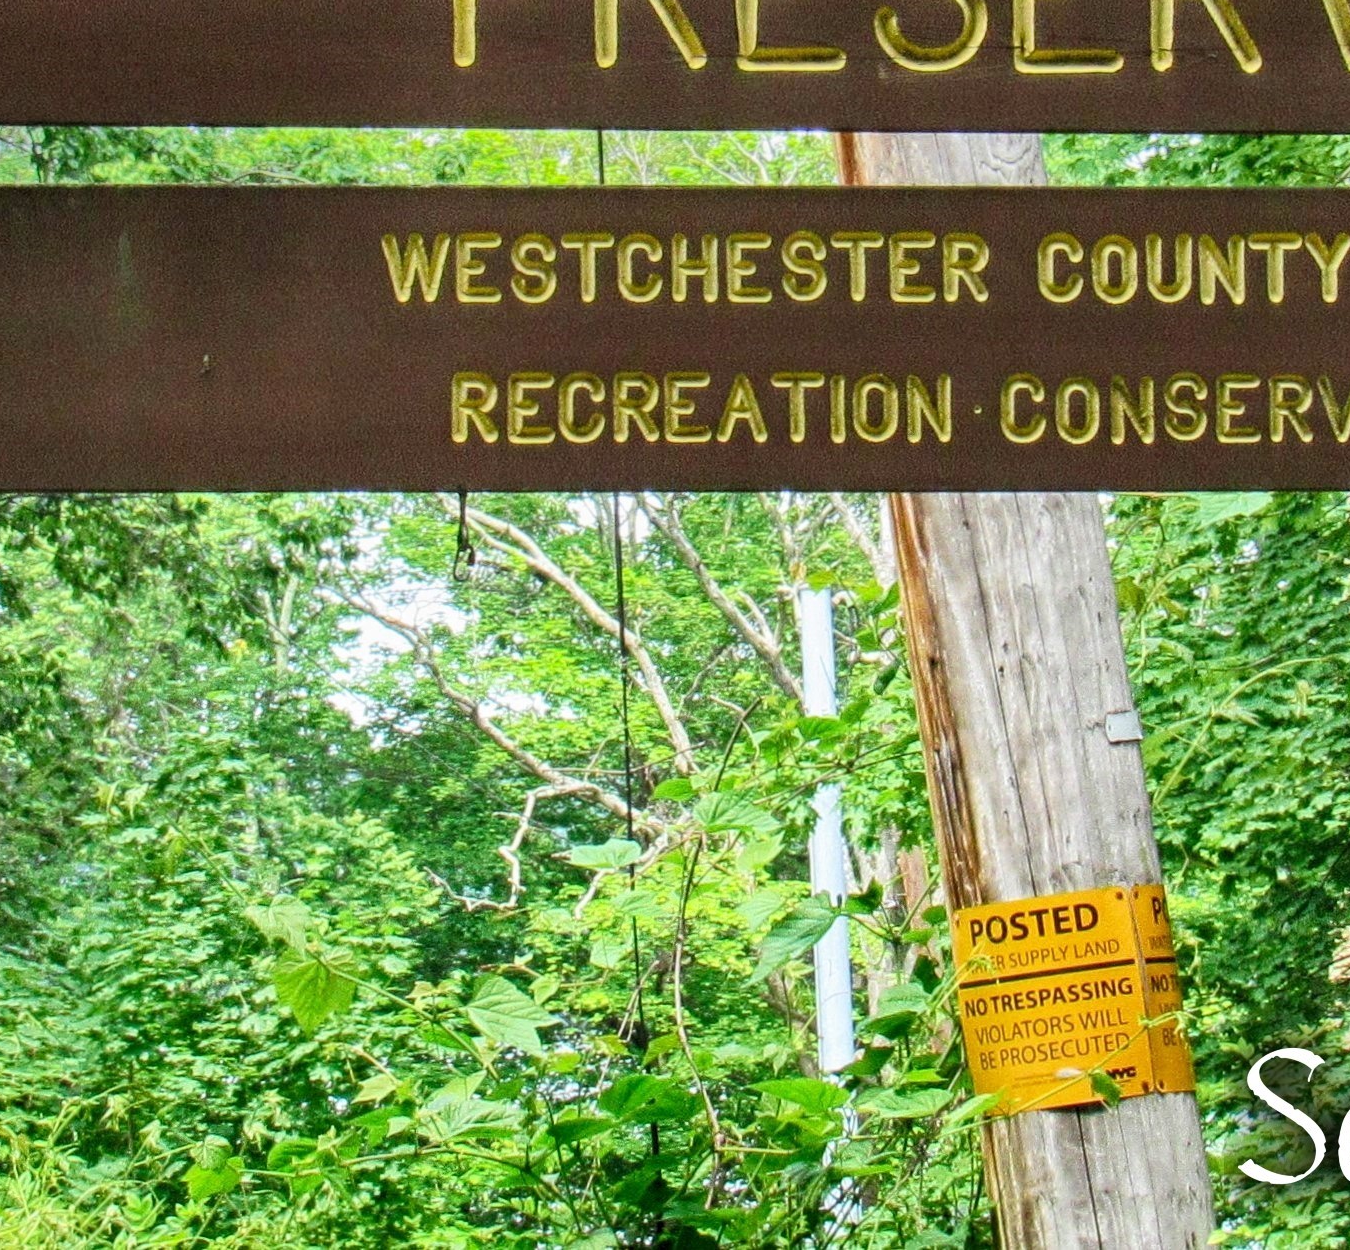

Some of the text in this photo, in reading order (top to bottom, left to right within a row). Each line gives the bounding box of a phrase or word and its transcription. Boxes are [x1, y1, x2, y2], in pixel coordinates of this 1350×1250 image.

[380, 230, 991, 308] WESTCHESTER
[449, 371, 954, 447] RECREATION
[969, 903, 1099, 947] POSTED
[1008, 945, 1069, 969] SUPPLY
[1073, 938, 1121, 959] LAND
[965, 997, 989, 1018] NO
[989, 977, 1134, 1014] TRESPASSING
[974, 1014, 1075, 1046] VIOLATORS
[1078, 1007, 1130, 1031] WILL
[979, 1031, 1131, 1071] BE PROSECUTED
